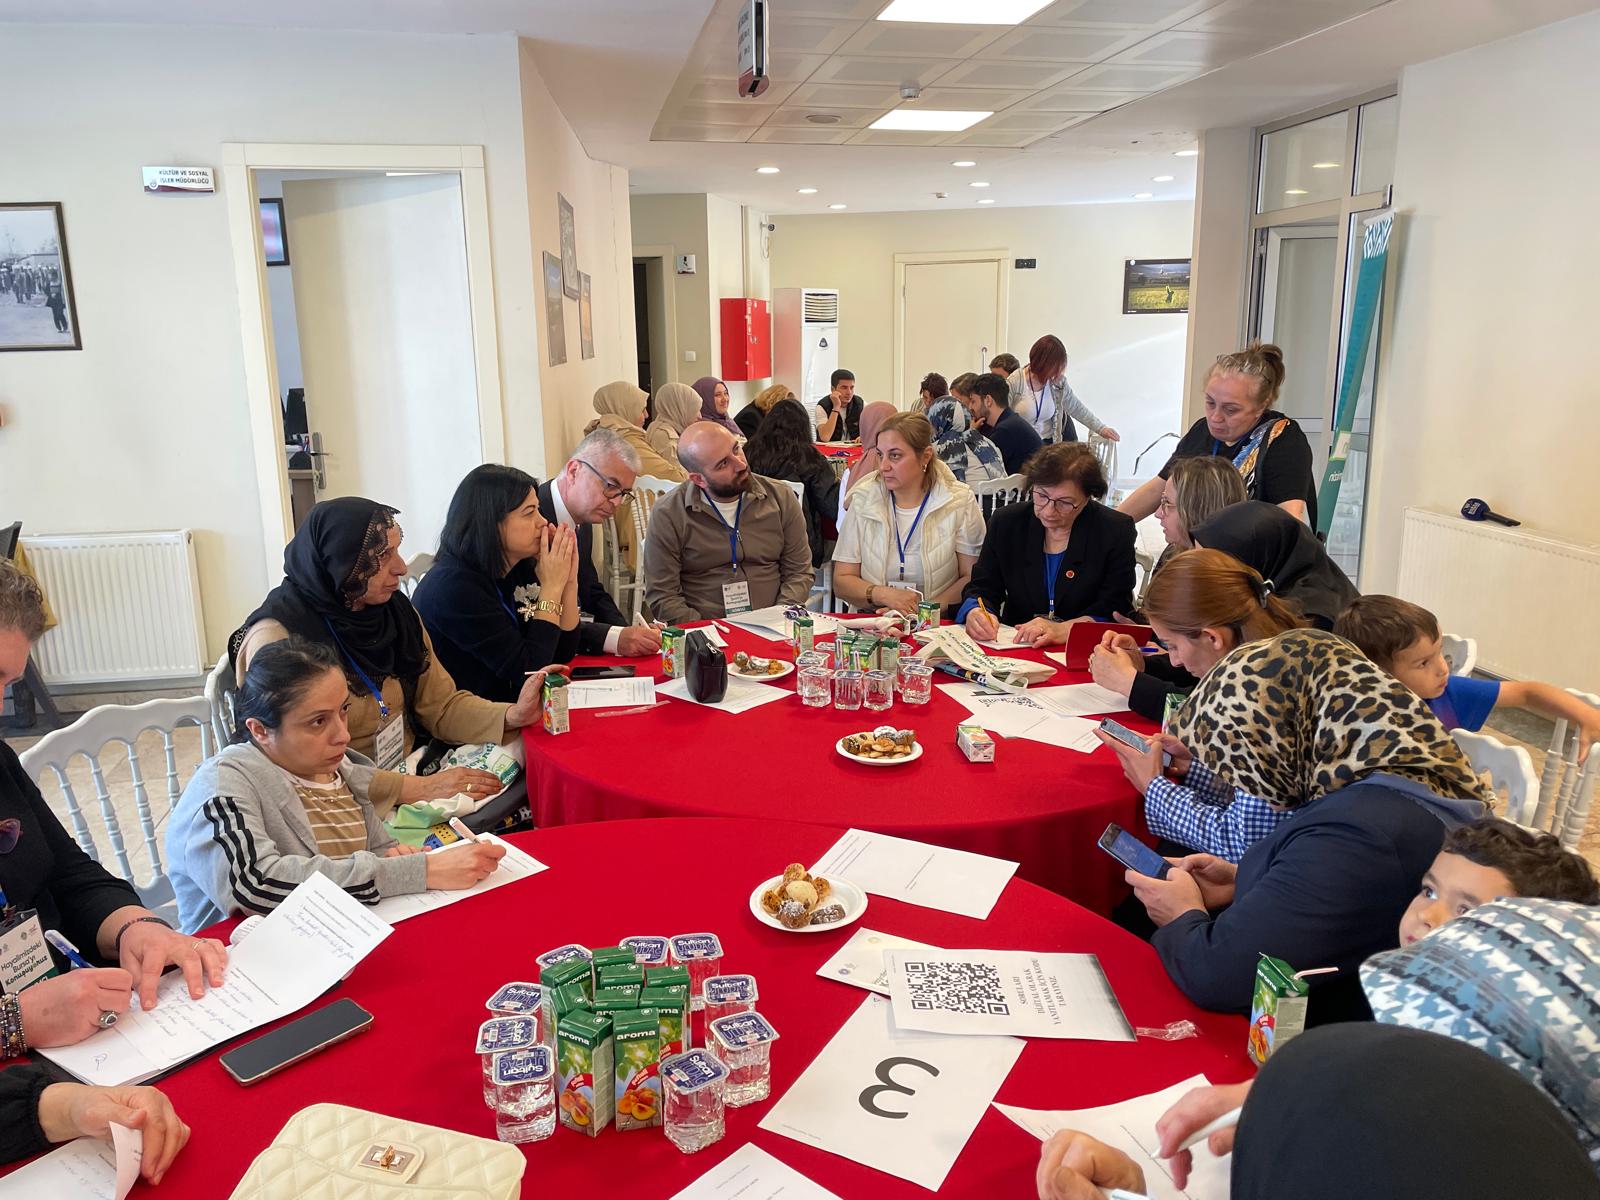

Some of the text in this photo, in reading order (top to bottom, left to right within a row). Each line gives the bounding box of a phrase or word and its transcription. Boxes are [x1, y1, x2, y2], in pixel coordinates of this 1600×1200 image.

[1, 941, 42, 971] Hayalimizdeki
[12, 954, 36, 973] Bursa'yı
[5, 955, 48, 986] Konuşuyoruz
[711, 980, 746, 988] Sultan
[507, 987, 540, 998] Sultan
[721, 1019, 757, 1031] Sultan
[558, 1030, 590, 1046] aroma
[616, 1030, 656, 1041] aroma
[503, 1064, 544, 1076] Sultan
[689, 1055, 715, 1078] Sultan
[858, 1056, 940, 1119] 3
